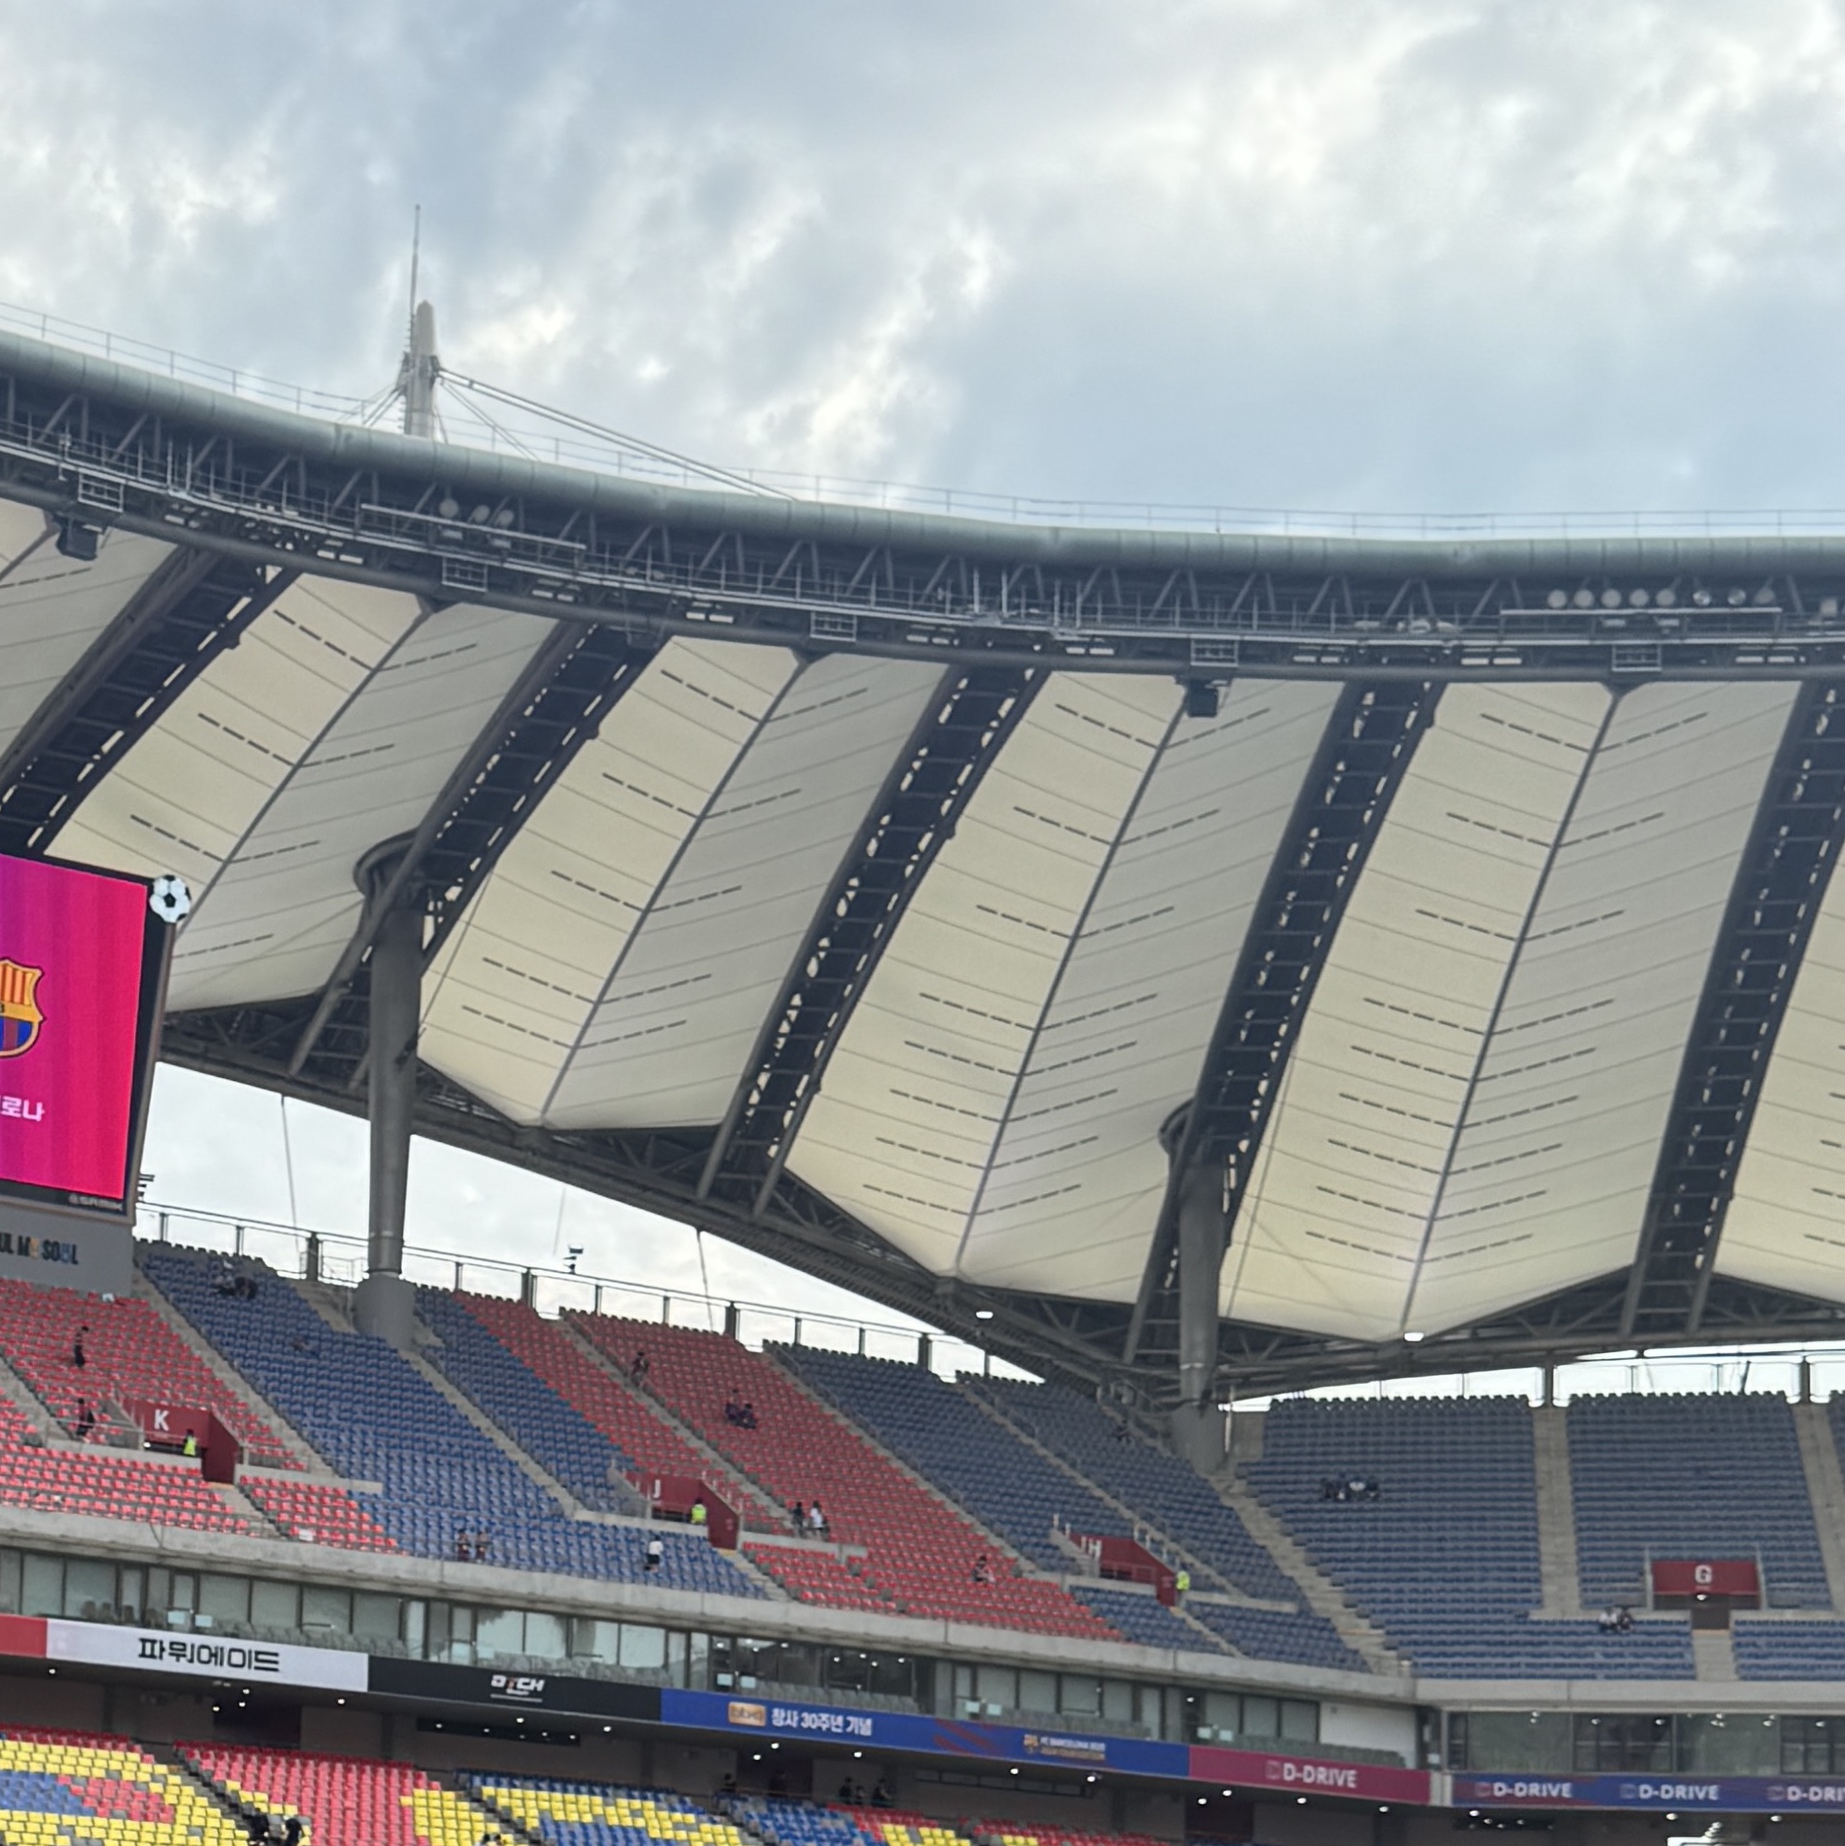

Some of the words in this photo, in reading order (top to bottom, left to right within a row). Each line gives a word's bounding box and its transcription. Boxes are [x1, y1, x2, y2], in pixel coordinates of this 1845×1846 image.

[154, 1408, 170, 1432] K
[1694, 1565, 1713, 1585] G
[138, 1638, 280, 1673] 파워에이드
[800, 1711, 844, 1734] 30주년
[1282, 1763, 1358, 1788] D-DRIVE
[1493, 1782, 1573, 1798] D-DRIVE
[1638, 1784, 1720, 1801] D-DRIVE
[1786, 1784, 1845, 1802] D-DRI
